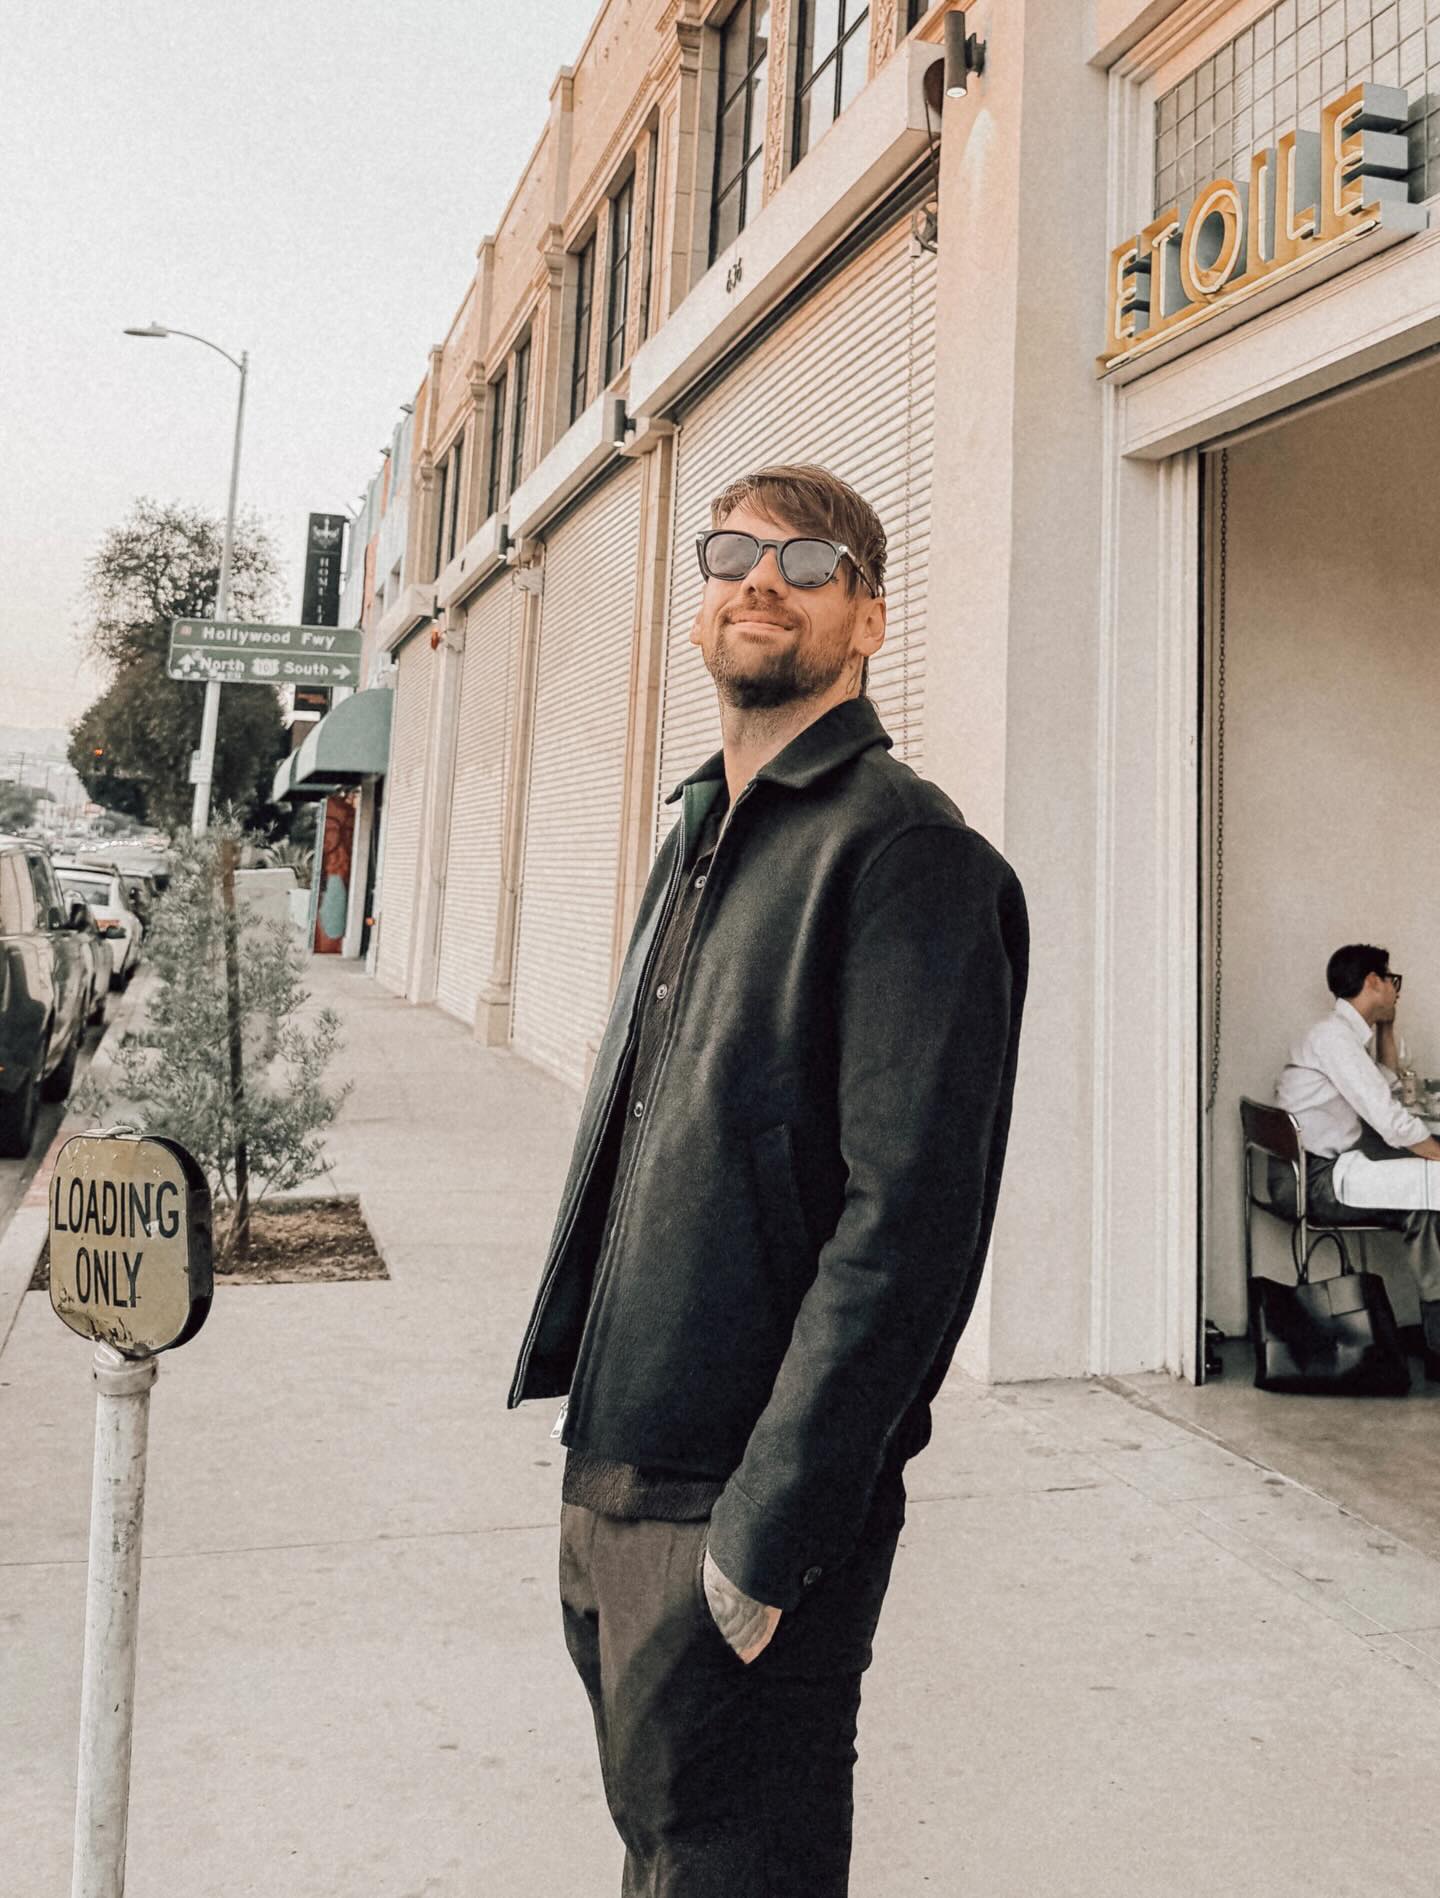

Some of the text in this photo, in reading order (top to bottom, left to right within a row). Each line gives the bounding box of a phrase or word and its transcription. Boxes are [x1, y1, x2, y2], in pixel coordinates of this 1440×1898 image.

[1104, 81, 1390, 357] ETOILE
[200, 656, 245, 673] North
[283, 662, 329, 676] South
[202, 626, 336, 650] Hollywood Fwy
[54, 1176, 180, 1239] LOADING
[76, 1246, 143, 1308] ONLY
